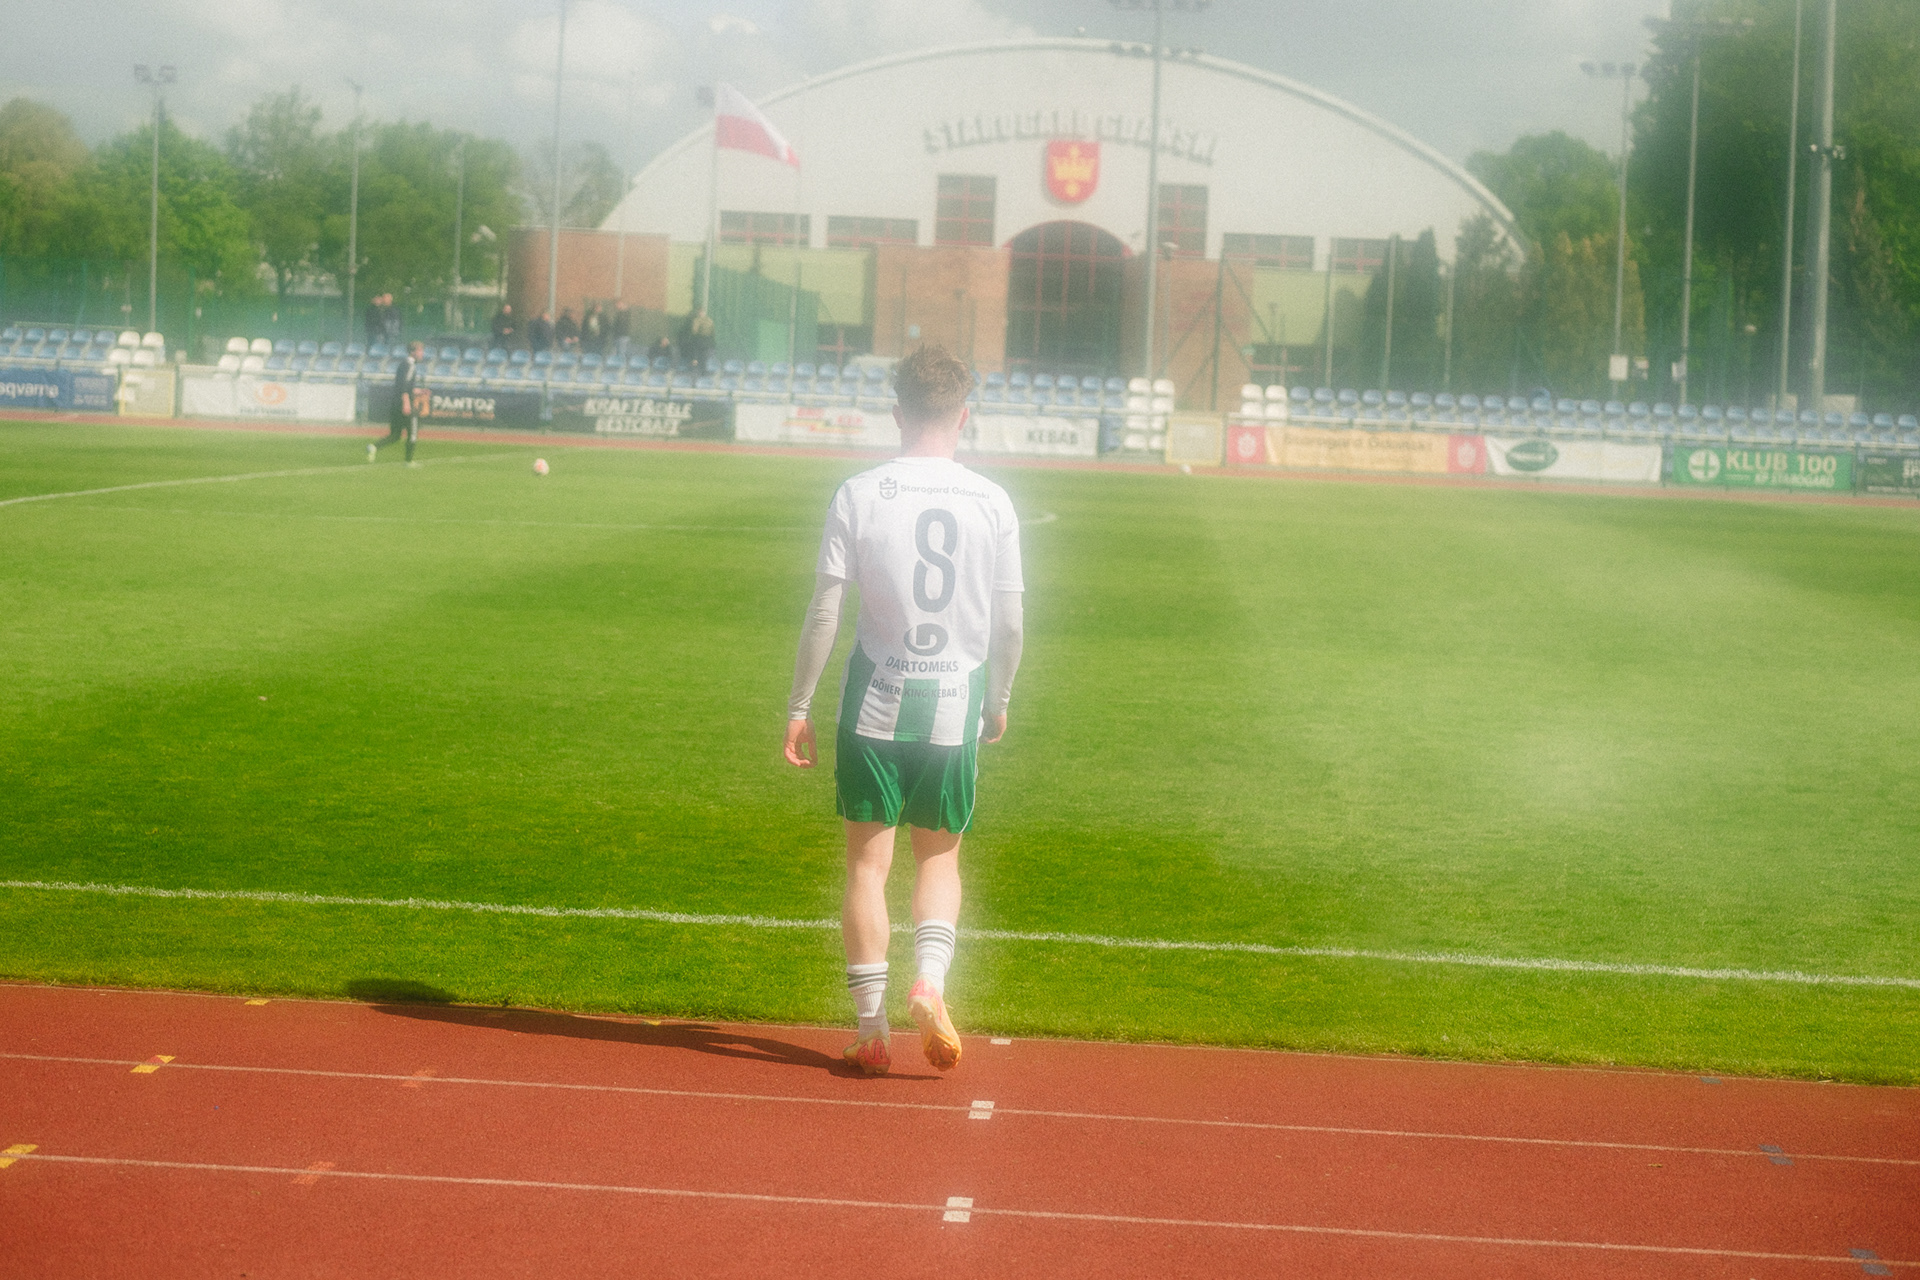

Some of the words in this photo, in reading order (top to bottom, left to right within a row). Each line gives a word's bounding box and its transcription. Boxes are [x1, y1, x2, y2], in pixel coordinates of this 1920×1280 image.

[1026, 429, 1078, 445] KEBAB
[1726, 450, 1788, 471] KLUB
[1797, 453, 1837, 475] 100
[900, 483, 950, 496] Starogard
[952, 486, 990, 500] Gdański
[912, 508, 958, 613] 8
[885, 655, 959, 674] DARTOMEKS
[904, 686, 928, 699] KING
[931, 686, 958, 699] KEBAB
